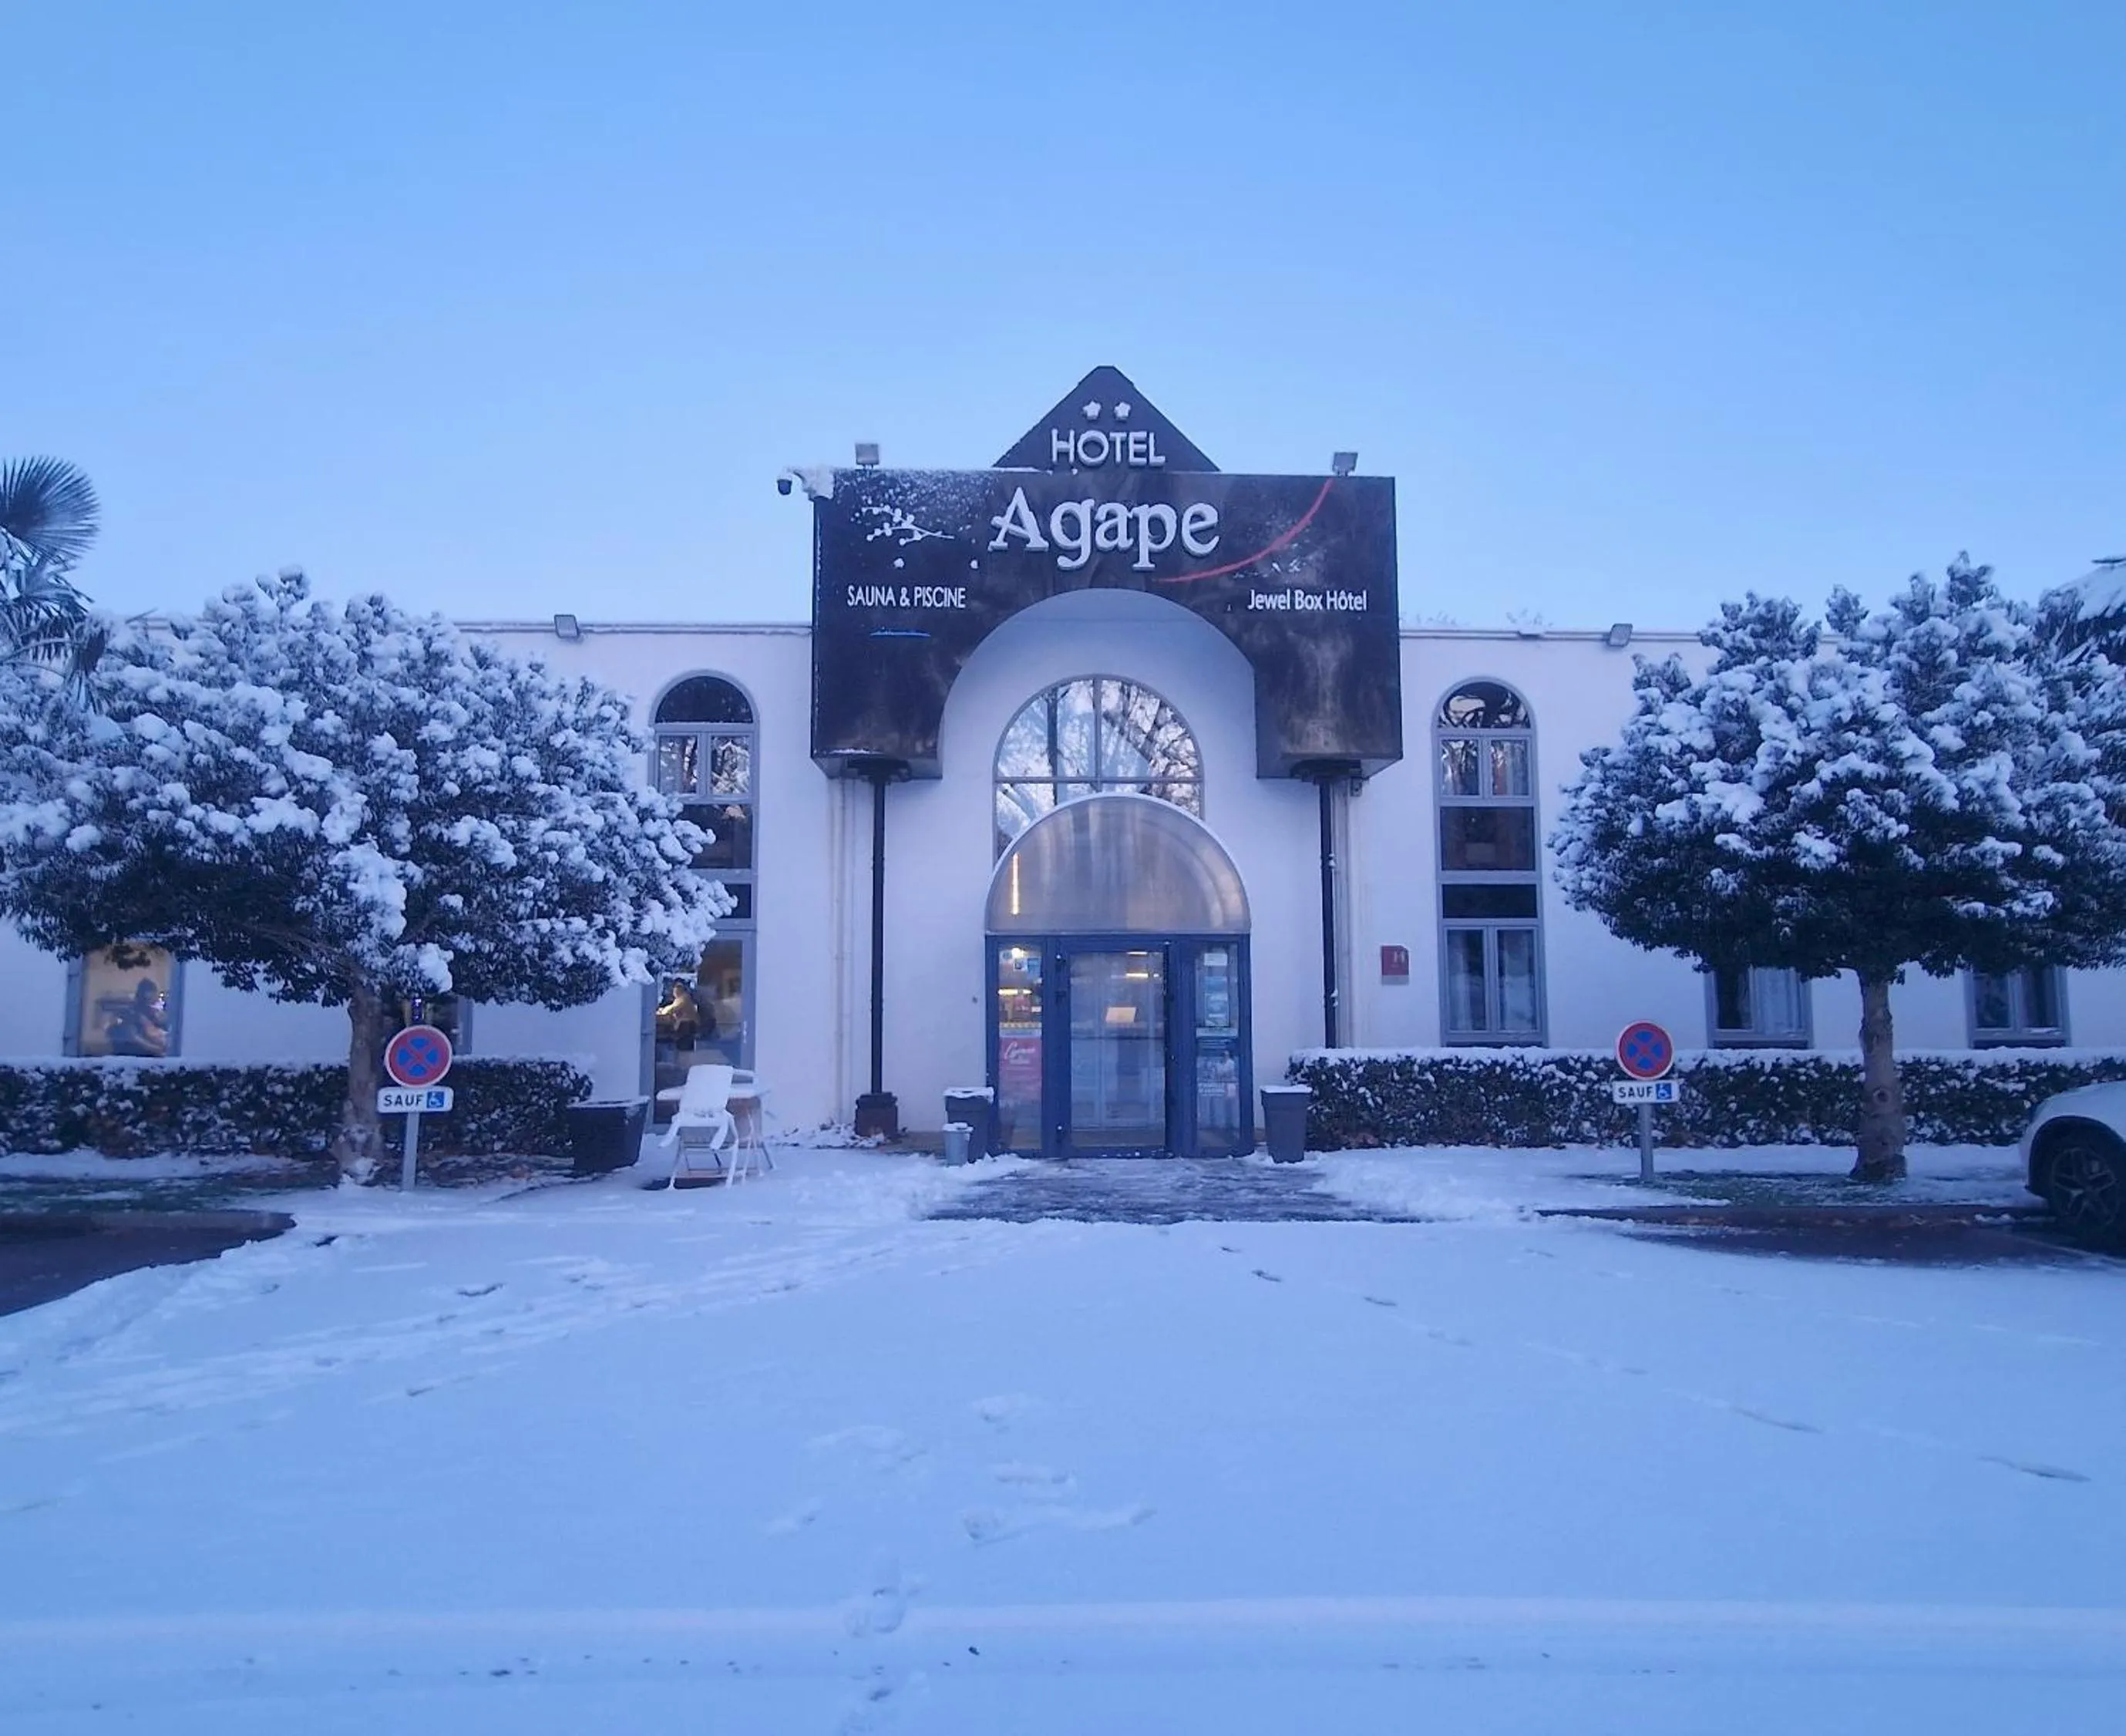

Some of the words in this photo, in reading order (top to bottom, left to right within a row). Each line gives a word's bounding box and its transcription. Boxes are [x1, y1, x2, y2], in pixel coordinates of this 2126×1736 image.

[1051, 429, 1166, 466] HOTEL
[987, 486, 1219, 570] Agape
[846, 584, 896, 607] SAUNA
[900, 587, 910, 607] &
[913, 586, 967, 608] PISCINE
[1247, 588, 1290, 611] Jewel
[1294, 589, 1323, 611] Box
[1326, 590, 1367, 611] Hôtel
[383, 1094, 424, 1107] SAUF
[1618, 1086, 1653, 1098] SAUF
